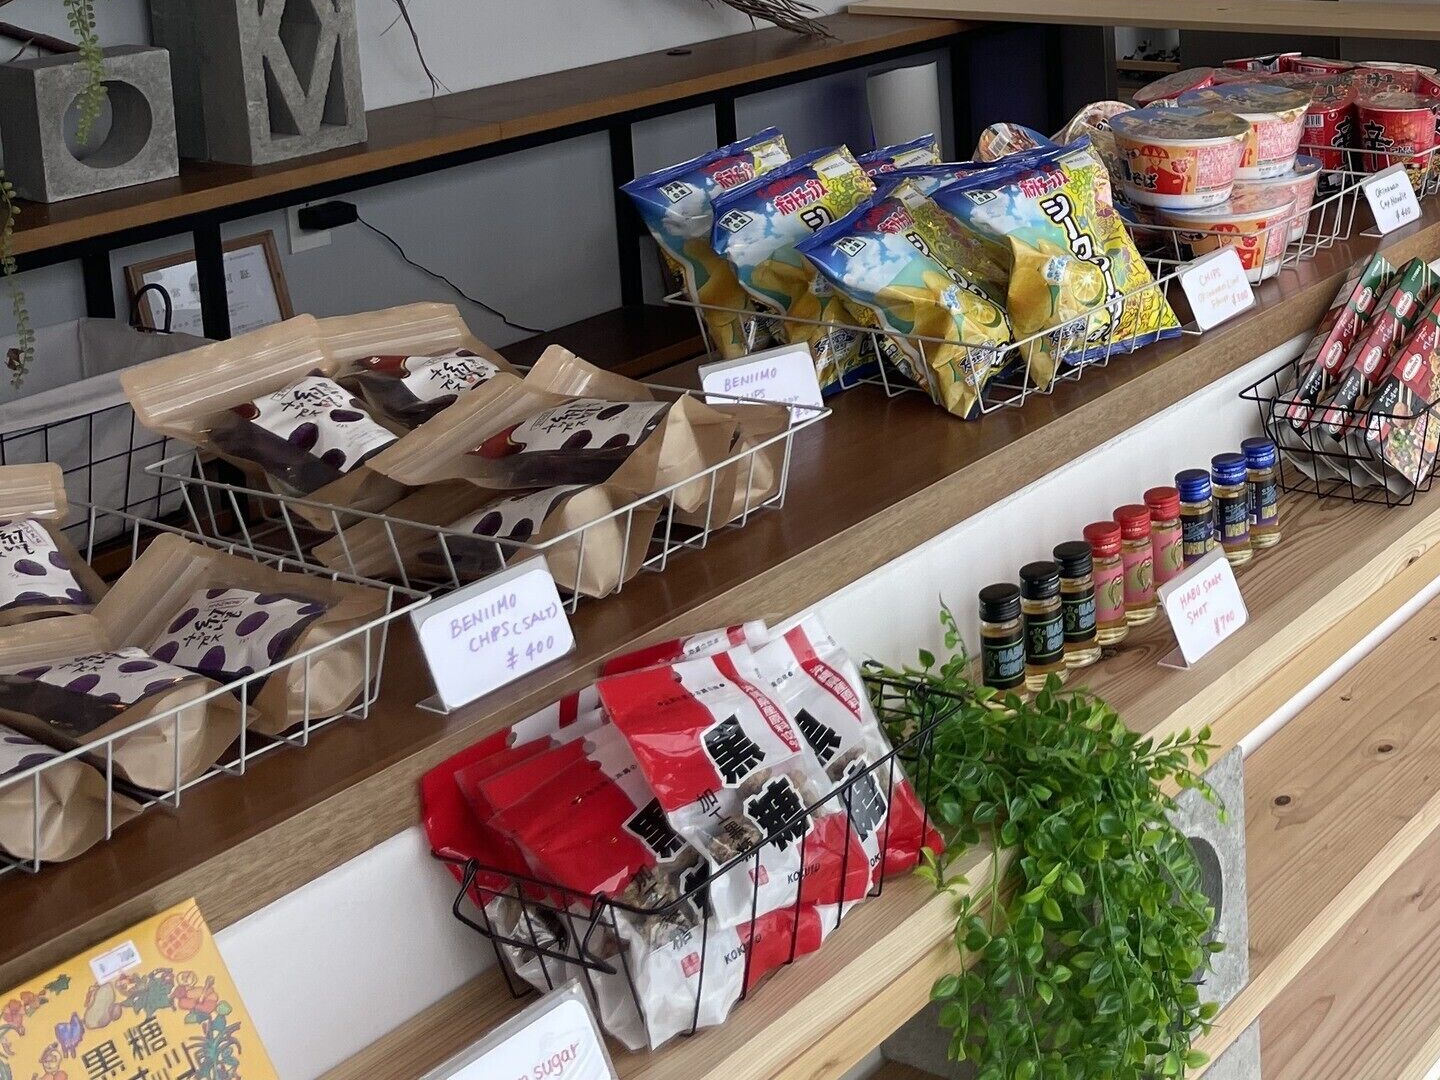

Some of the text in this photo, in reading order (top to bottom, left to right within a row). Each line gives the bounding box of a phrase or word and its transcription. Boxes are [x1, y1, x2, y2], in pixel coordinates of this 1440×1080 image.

[724, 367, 778, 392] BENIIMO
[451, 593, 517, 639] BENIIMO
[525, 635, 555, 662] 400
[701, 713, 813, 853] 黒糖
[81, 1016, 167, 1077] 黒糖
[533, 1042, 580, 1080] sugar
